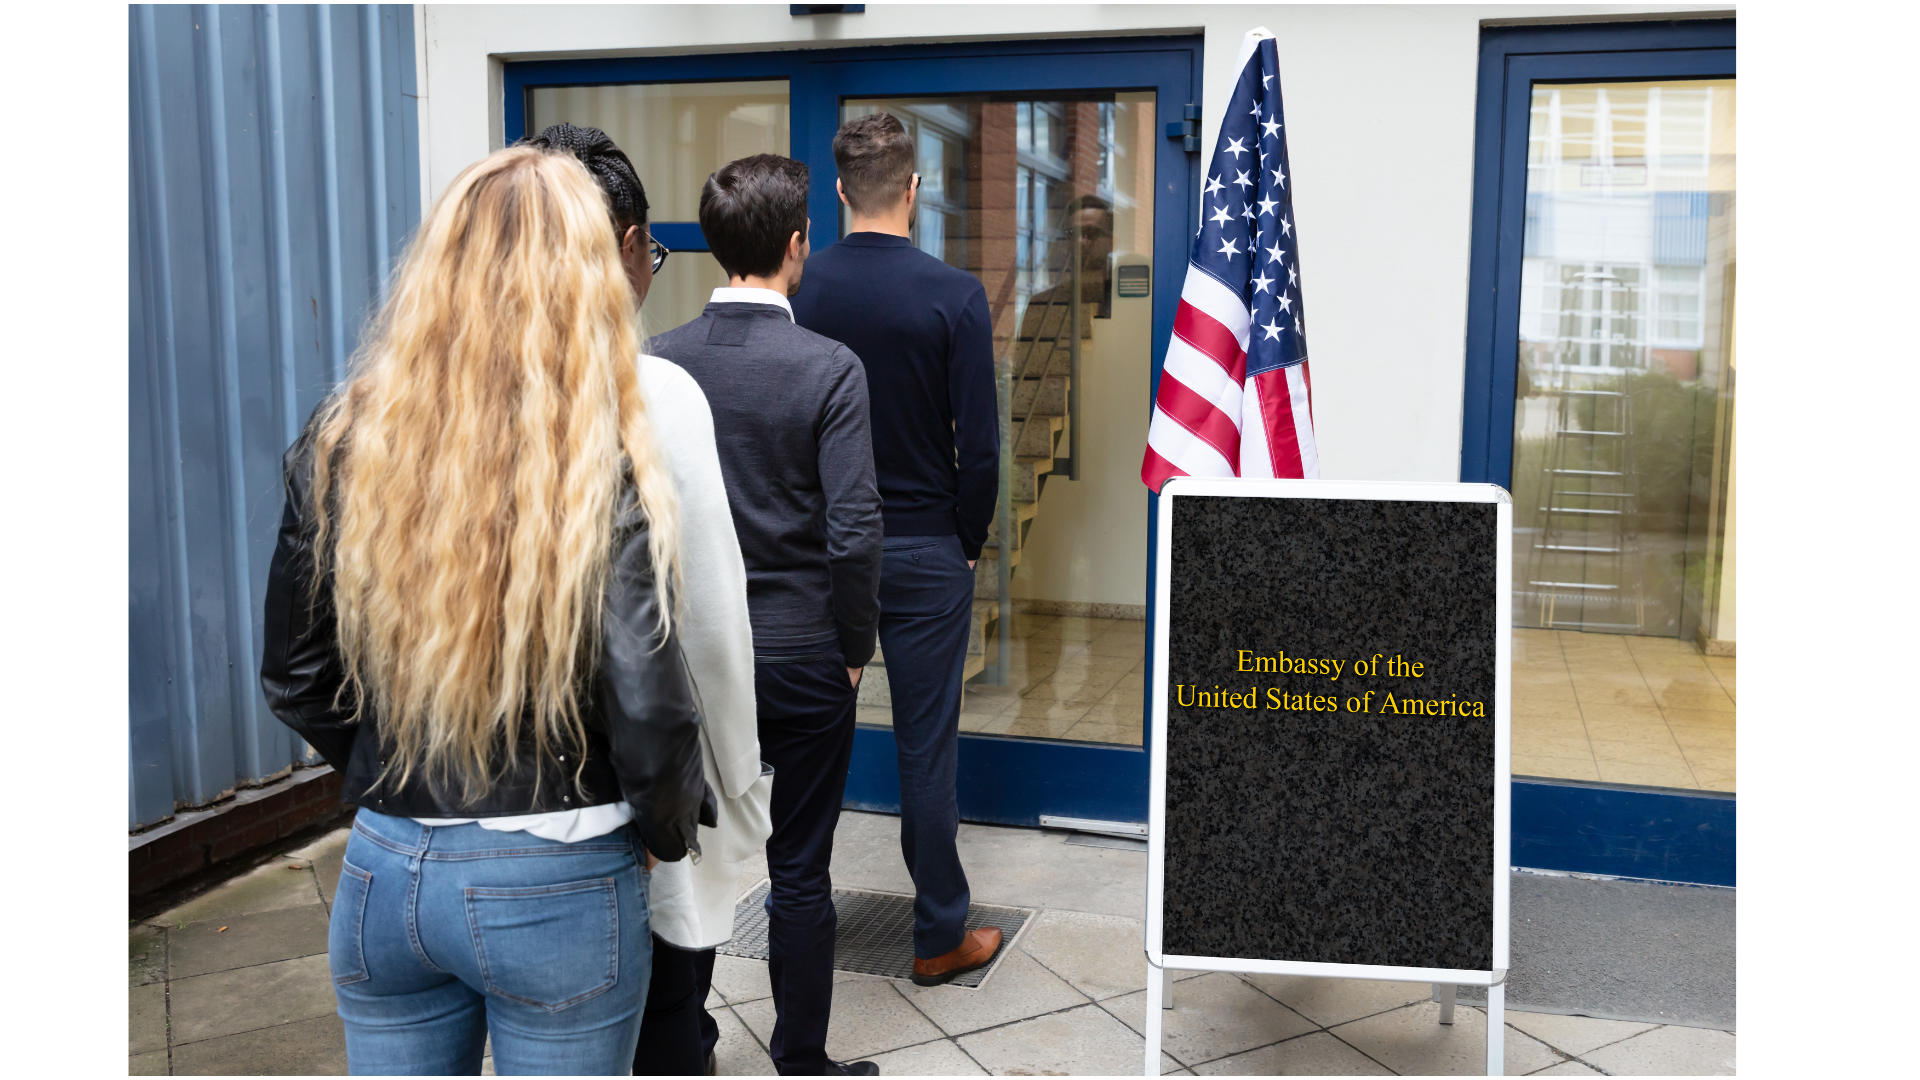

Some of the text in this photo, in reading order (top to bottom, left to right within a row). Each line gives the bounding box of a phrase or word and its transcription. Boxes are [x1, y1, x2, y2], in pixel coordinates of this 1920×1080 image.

[1236, 650, 1424, 681] Embassy of the
[1176, 685, 1486, 717] United States of America
